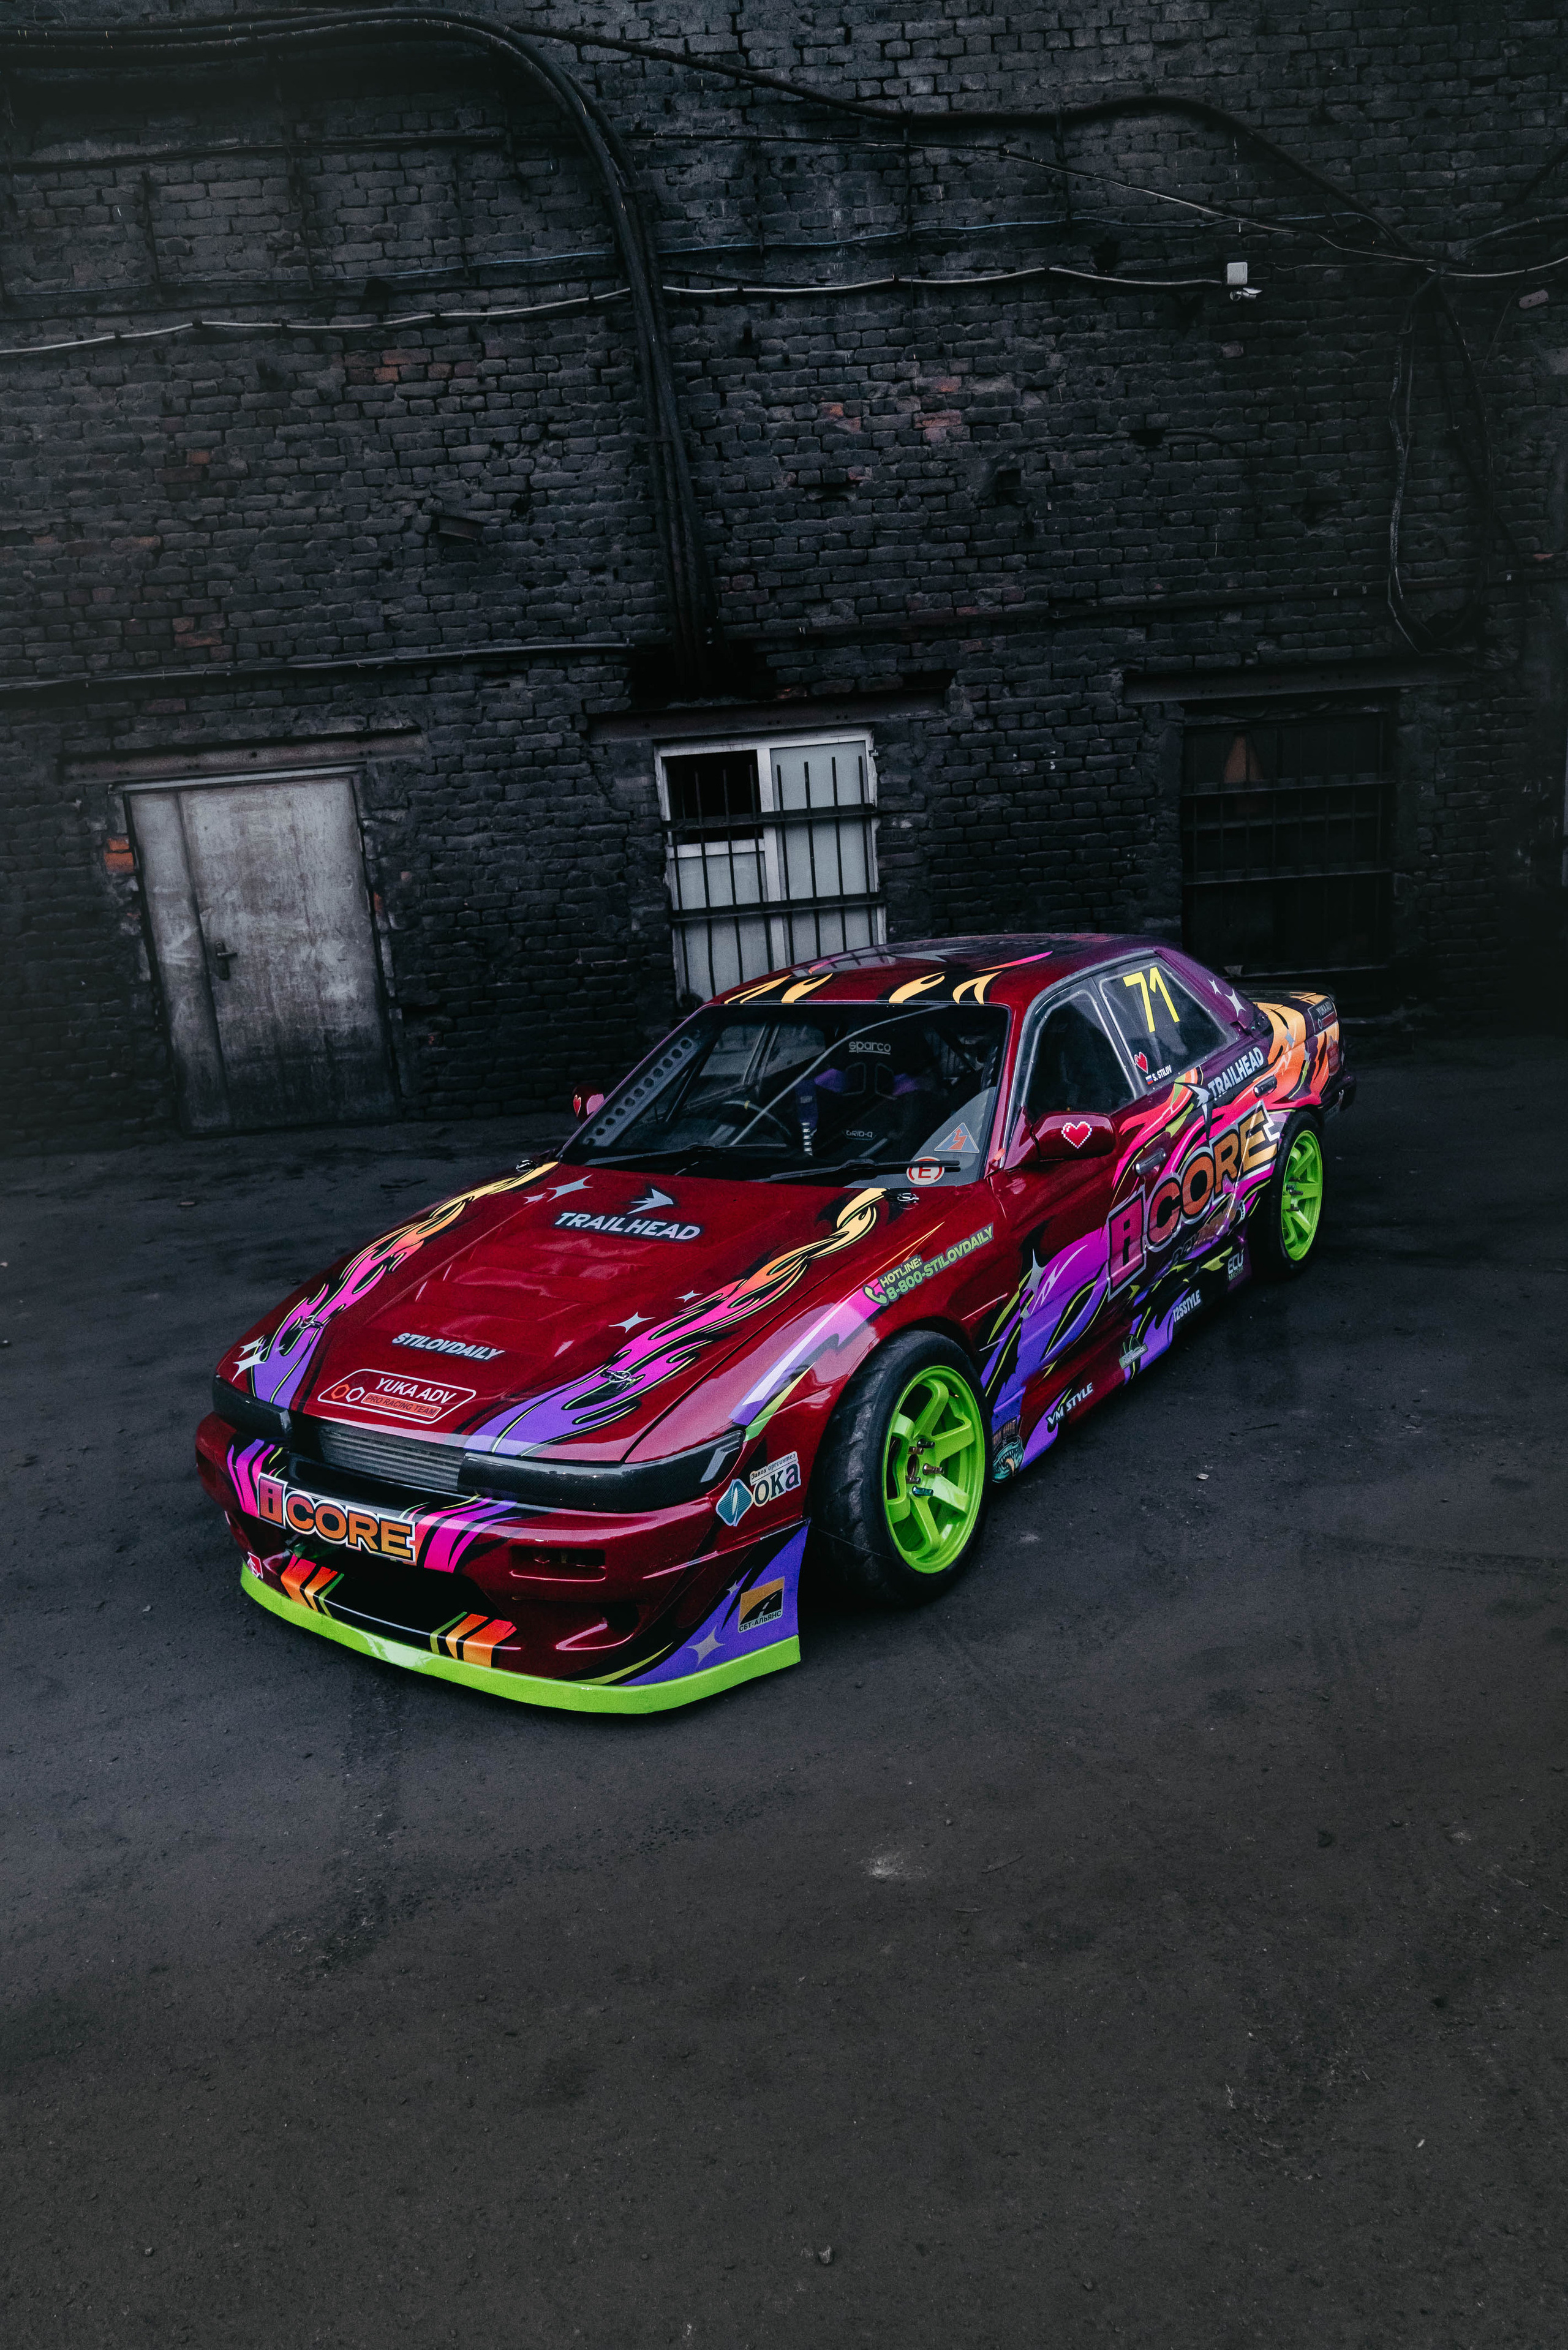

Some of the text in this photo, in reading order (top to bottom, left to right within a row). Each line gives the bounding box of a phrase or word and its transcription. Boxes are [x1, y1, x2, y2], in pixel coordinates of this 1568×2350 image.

[1123, 966, 1180, 1033] 71
[848, 1041, 892, 1054] sparco
[1156, 1064, 1172, 1079] STILOV
[1207, 1047, 1264, 1098] TRAILHEAD
[918, 1166, 932, 1179] E
[554, 1211, 701, 1240] TRAILHEAD
[880, 1258, 922, 1288] HOTLINE:
[886, 1226, 993, 1301] 8-800-STILOVDAILY
[1227, 1252, 1244, 1275] ECU
[392, 1332, 506, 1360] STILOVDAILY
[375, 1377, 457, 1404] YUKA ADV
[1047, 1382, 1094, 1425] VM STYLE
[366, 1395, 437, 1416] PRO RACING TEAM
[739, 1610, 782, 1632] СБТ-АЛЬЯНС
